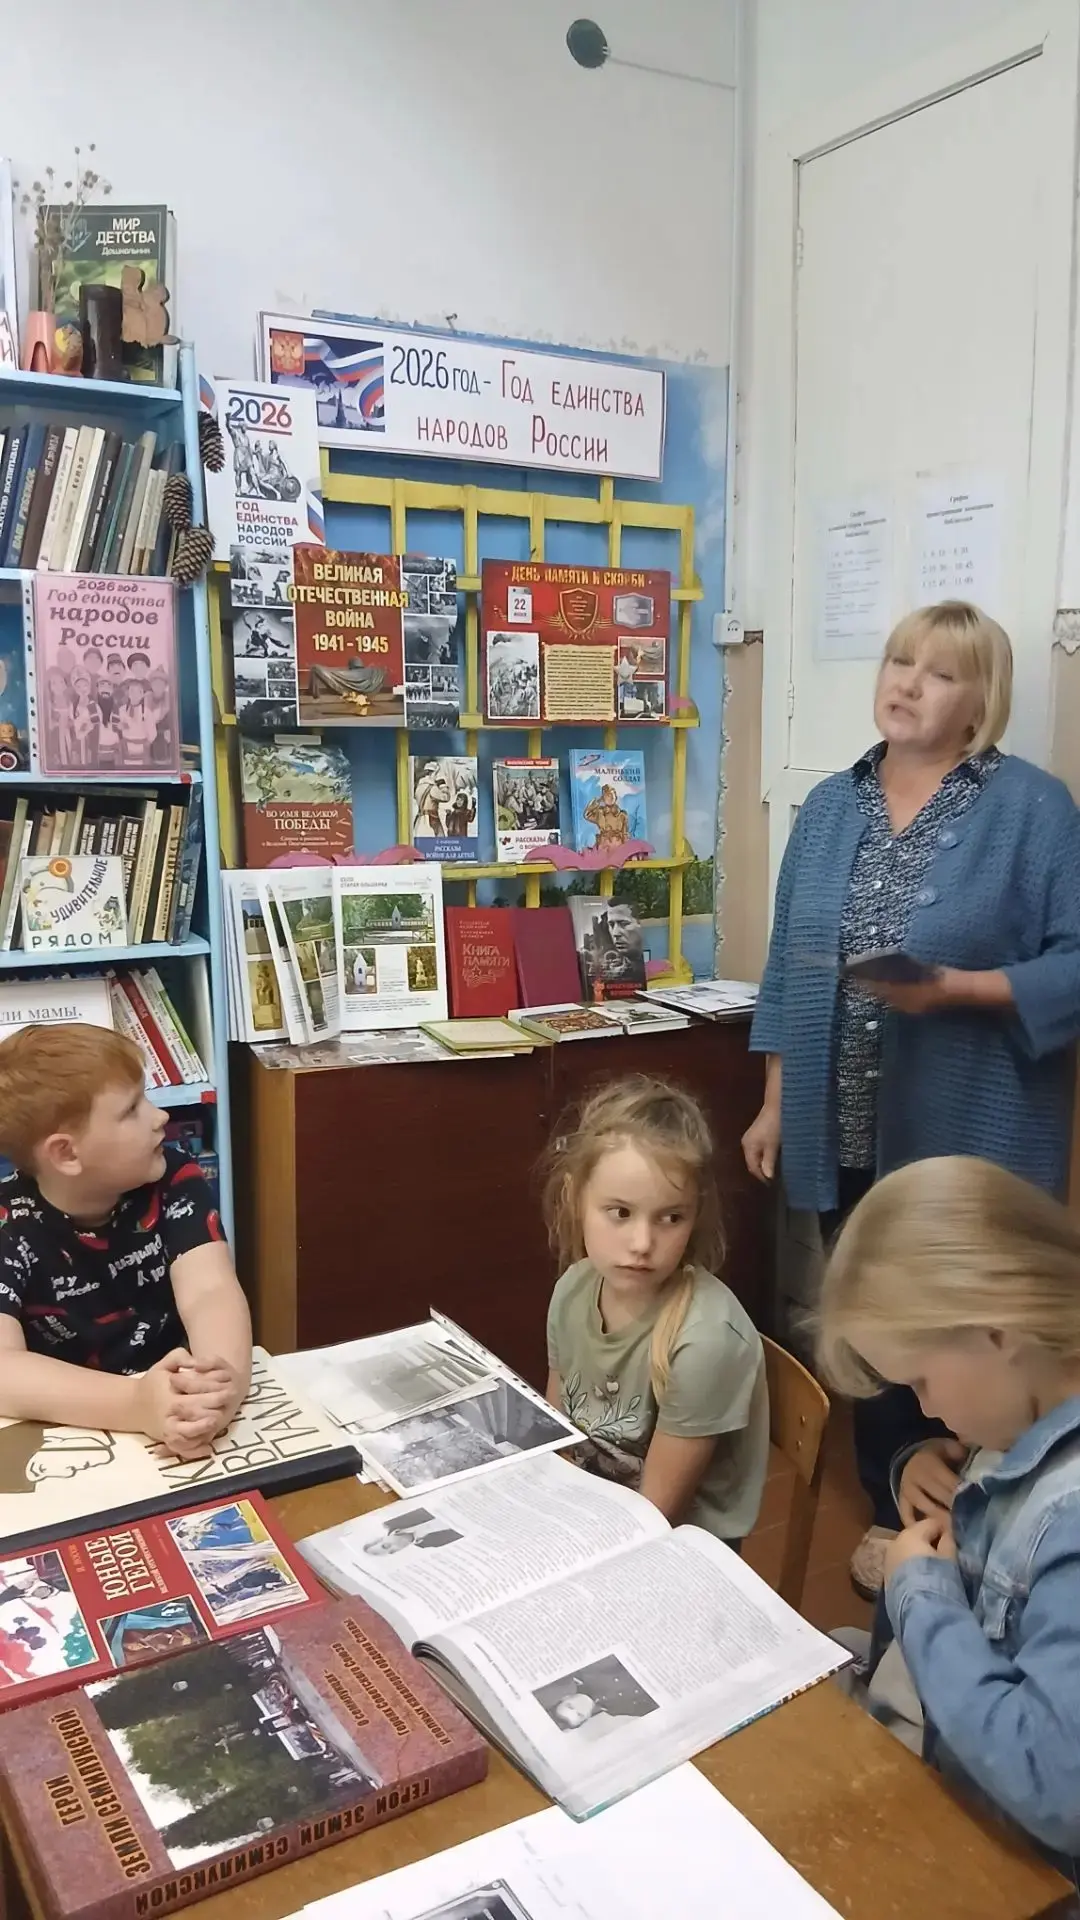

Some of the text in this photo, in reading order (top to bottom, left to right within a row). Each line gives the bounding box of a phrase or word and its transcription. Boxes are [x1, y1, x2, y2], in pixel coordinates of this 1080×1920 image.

[112, 217, 140, 231] МИР
[96, 230, 156, 246] ДЕТСТВА
[390, 346, 449, 389] 2026
[228, 396, 292, 428] 2026
[236, 501, 260, 513] ГОД
[236, 512, 298, 526] ЕДИНСТВА
[238, 524, 294, 537] НАРОДОВ
[238, 535, 287, 547] РОССИИ
[313, 563, 384, 584] ВЕЛИКАЯ
[512, 566, 540, 582] ДЕНЬ
[544, 568, 589, 584] ПАМЯТИ
[592, 572, 600, 585] И
[76, 580, 115, 591] 2026
[118, 585, 138, 593] год
[287, 584, 409, 608] ОТЕЧЕСТВЕННАЯ
[46, 590, 166, 608] Год единства
[514, 599, 526, 610] 22
[50, 603, 159, 626] народов
[326, 608, 374, 628] ВОЙНА
[58, 628, 150, 650] России
[266, 810, 338, 818] ВО ИМЯ ВЕЛИКОЙ
[274, 818, 330, 830] ПОБЕДЫ
[50, 857, 108, 924] УДИВИТЕЛЬНОЕ
[32, 932, 112, 948] РЯДОМ
[462, 944, 500, 956] КНИГА
[464, 956, 510, 967] ПАМЯТИ
[28, 1006, 82, 1020] мамы.
[84, 1537, 130, 1600] ЮНЫЕ
[109, 1530, 155, 1594] ГЕРОИ
[363, 1641, 387, 1670] ордена
[330, 1640, 409, 1737] Героях Советского Союза
[384, 1667, 418, 1708] кавалерах
[414, 1704, 443, 1739] полных
[44, 1773, 86, 1826] ГЕРОИ
[49, 1708, 151, 1880] ЗЕМЛИ СЕМИЛУКСКОЙ
[135, 1776, 431, 1916] ГЕРОИ ЗЕМЛИ СЕМИЛУКСКОЙ
